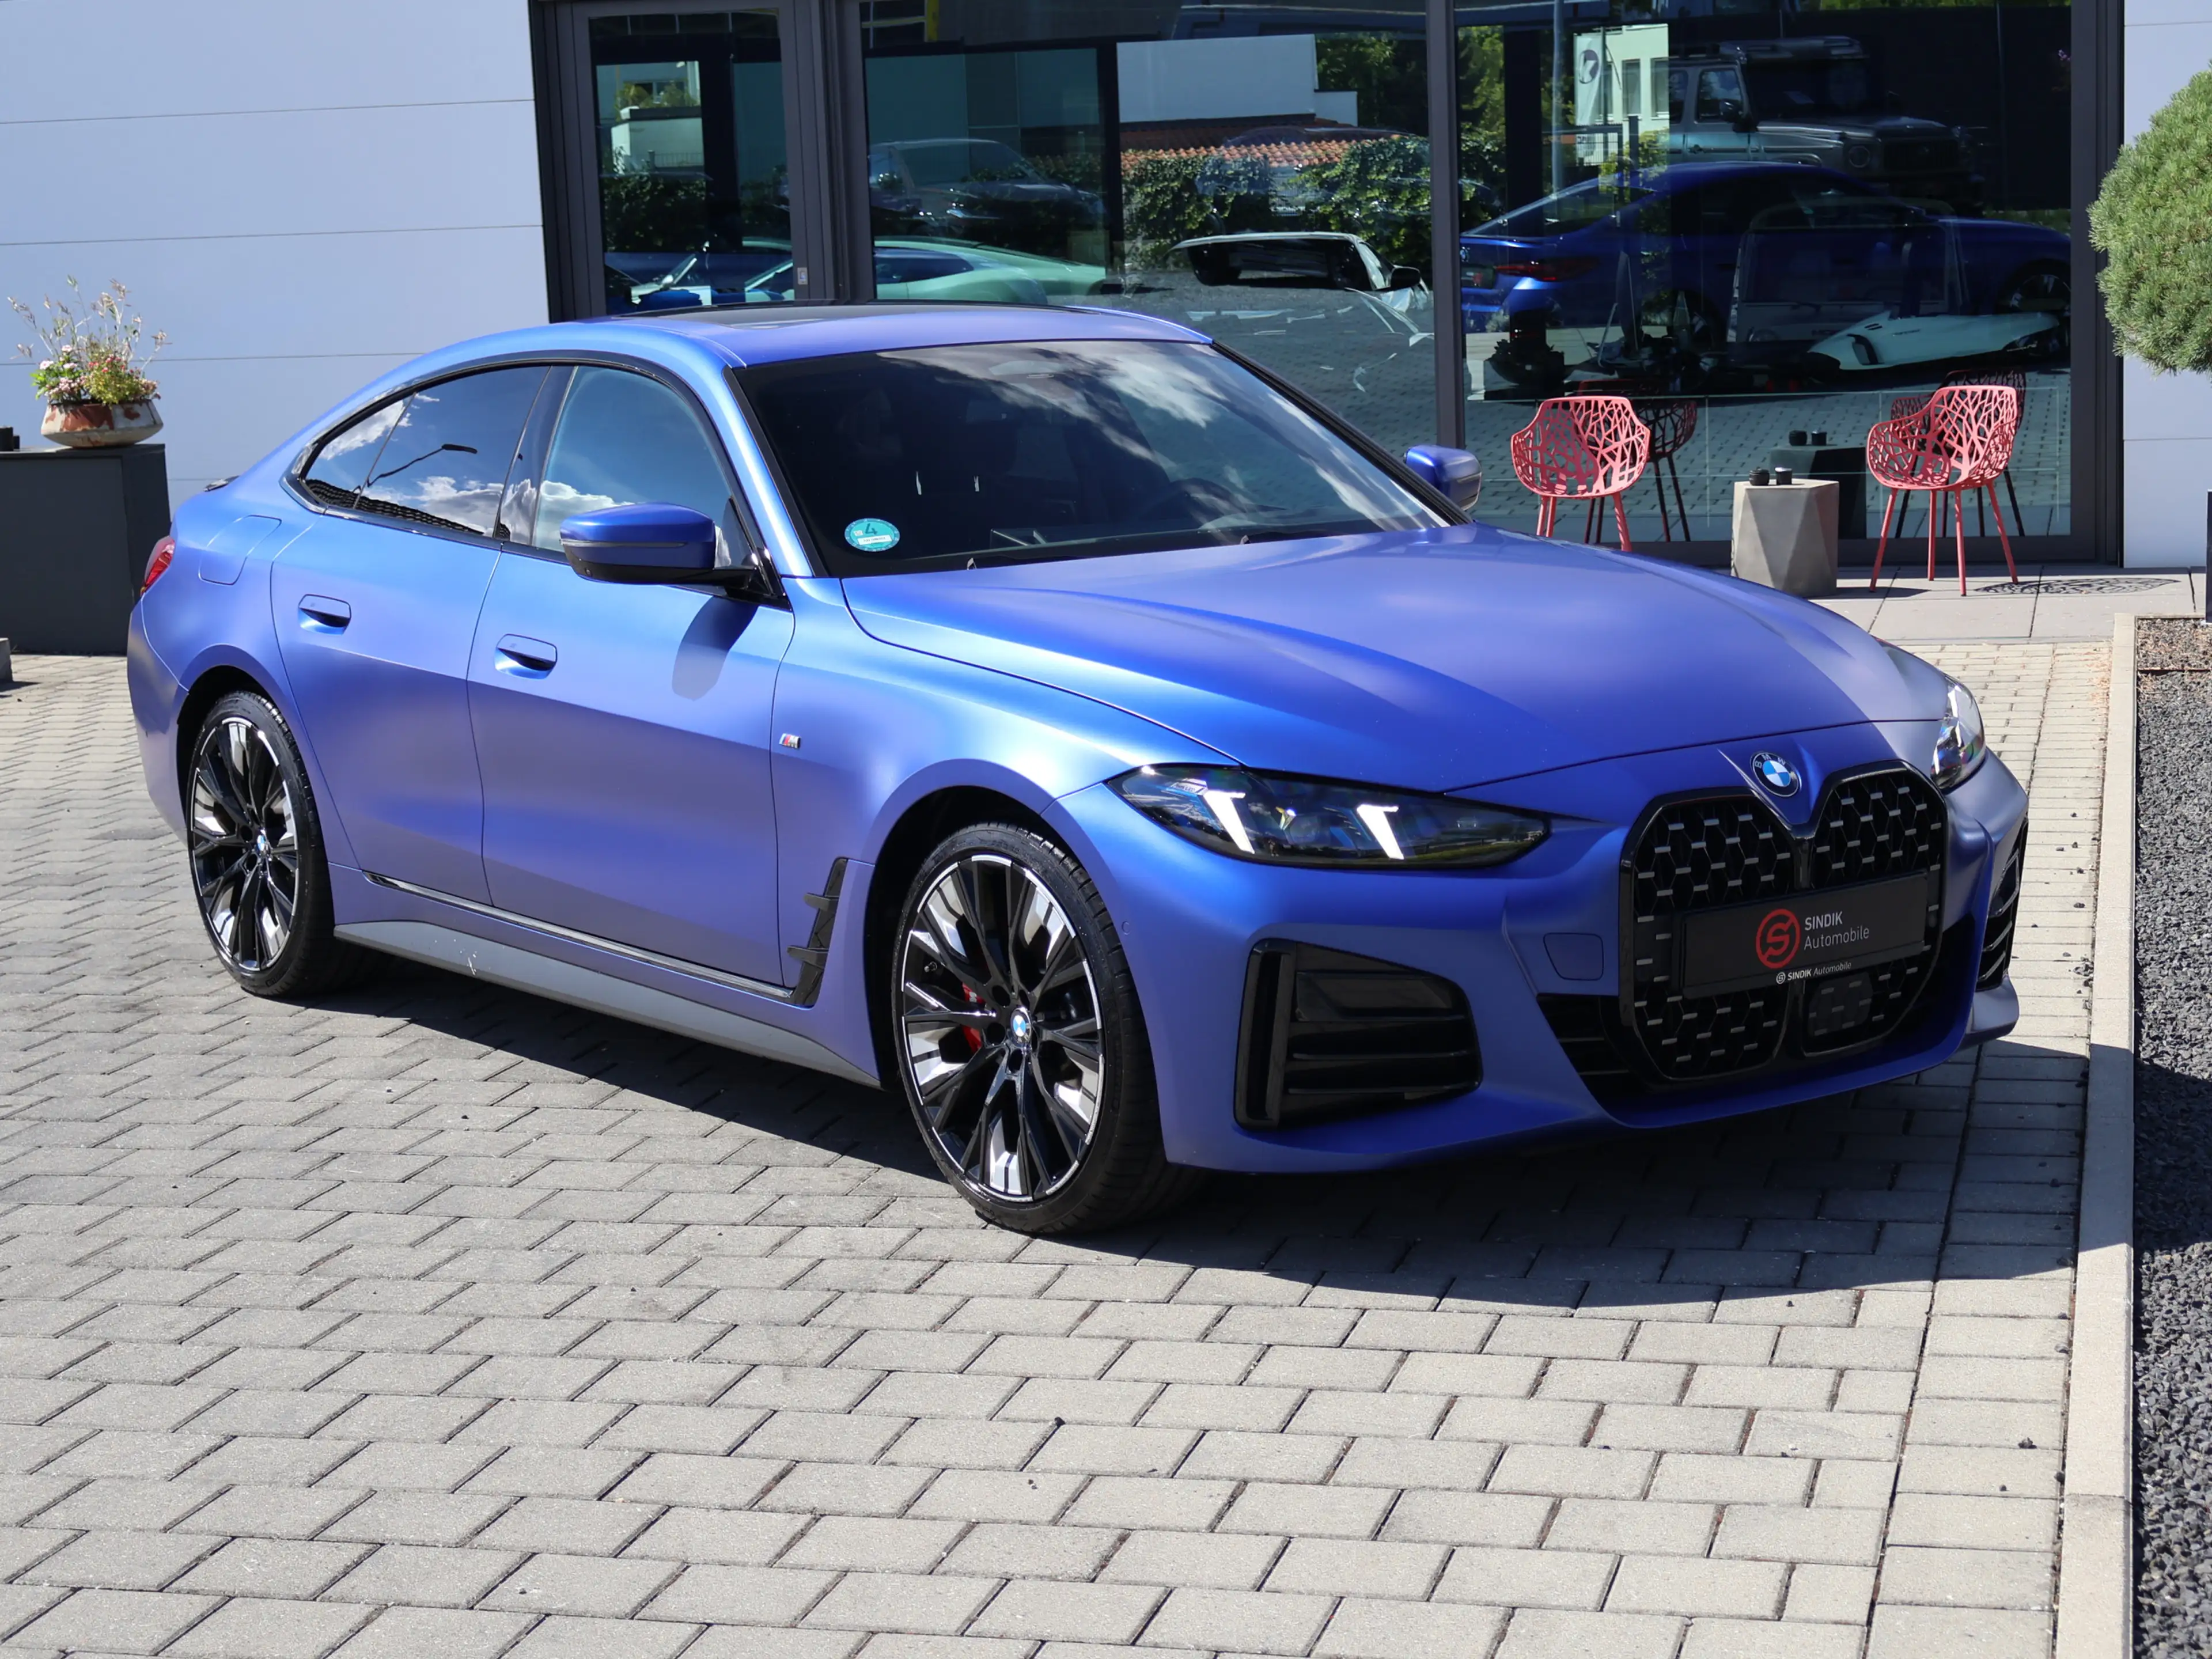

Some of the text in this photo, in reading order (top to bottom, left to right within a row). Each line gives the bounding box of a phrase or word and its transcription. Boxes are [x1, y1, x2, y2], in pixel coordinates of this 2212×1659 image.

[865, 522, 878, 535] 4
[1754, 753, 1786, 768] BMW
[1804, 911, 1843, 931] SINDIK
[1804, 925, 1870, 950] Automobile
[1787, 968, 1812, 981] SINDIK
[1813, 961, 1852, 976] Automobile
